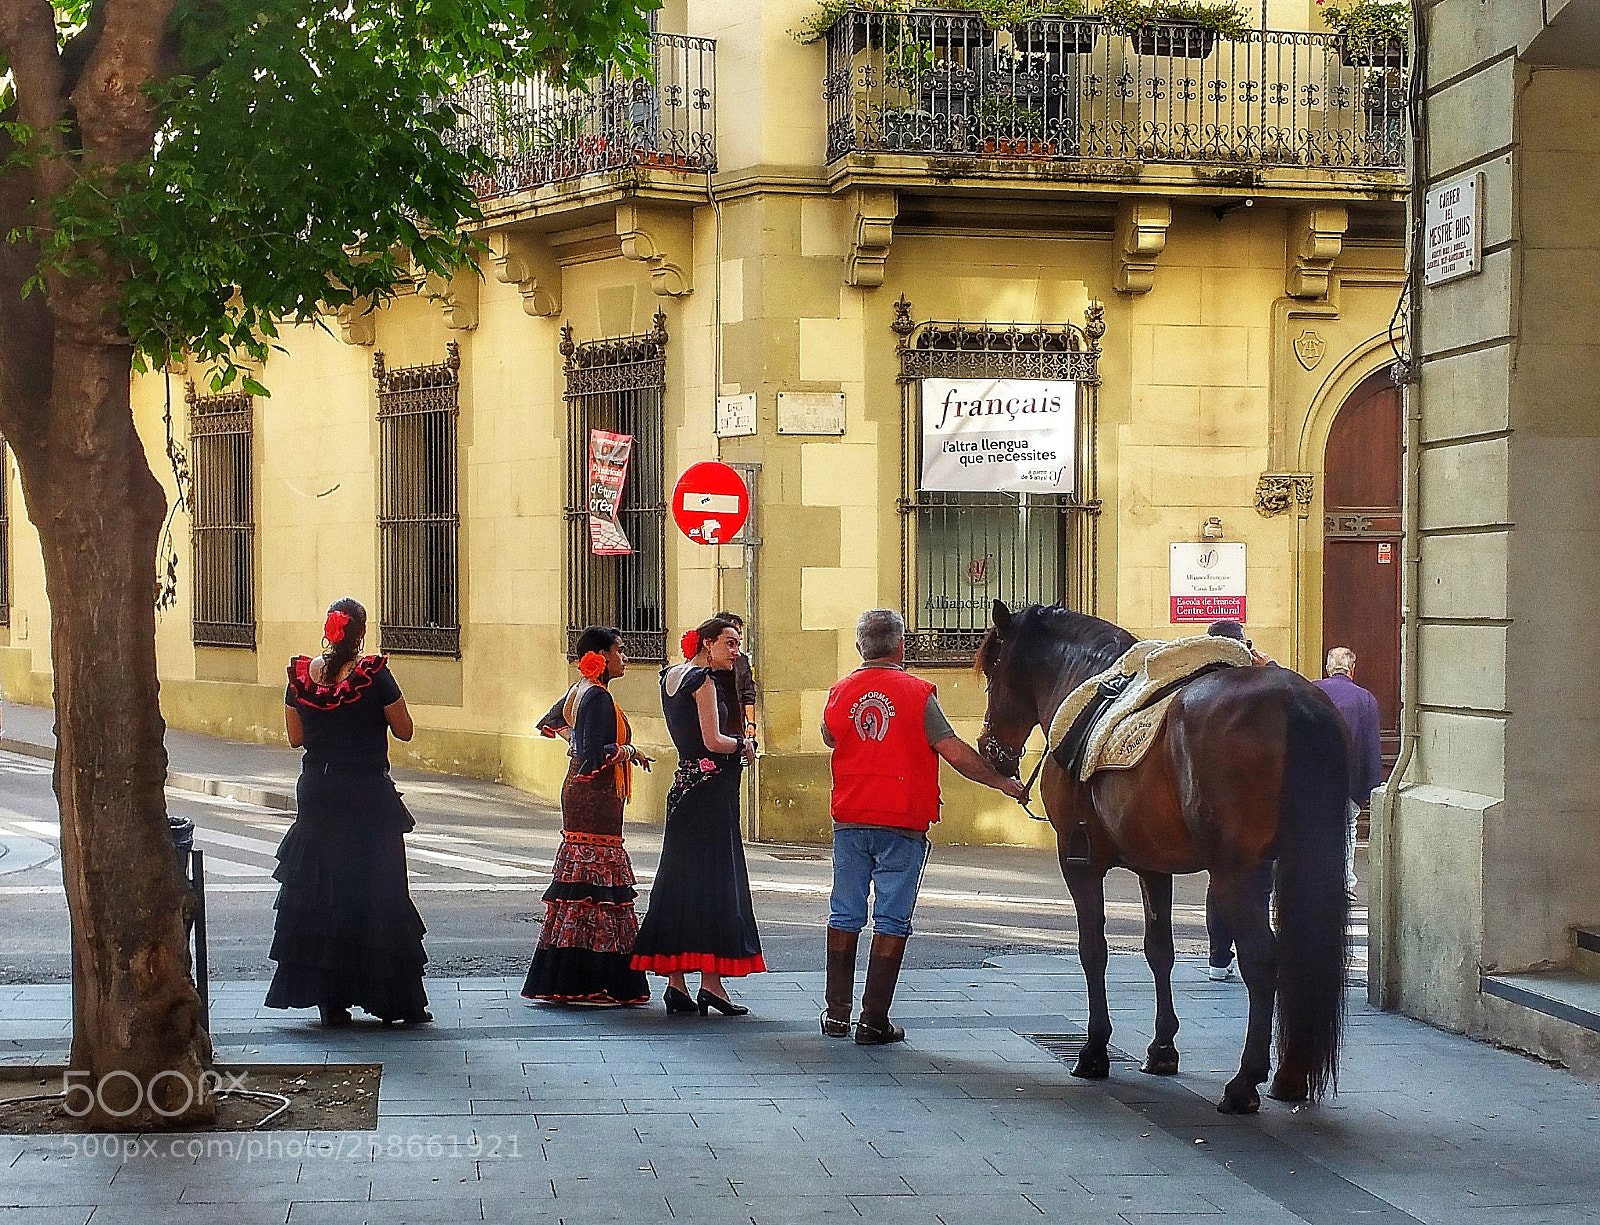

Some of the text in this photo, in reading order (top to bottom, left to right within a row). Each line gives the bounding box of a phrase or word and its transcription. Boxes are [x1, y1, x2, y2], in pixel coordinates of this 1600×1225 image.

[1429, 215, 1471, 249] MESTRE RIUS
[935, 388, 1061, 429] français
[942, 438, 1029, 453] l'altra llengua
[959, 450, 1057, 467] que necessites
[1176, 597, 1201, 606] Escola
[1201, 597, 1212, 606] de
[1176, 605, 1240, 615] Centre Cultural
[848, 702, 859, 719] LOS
